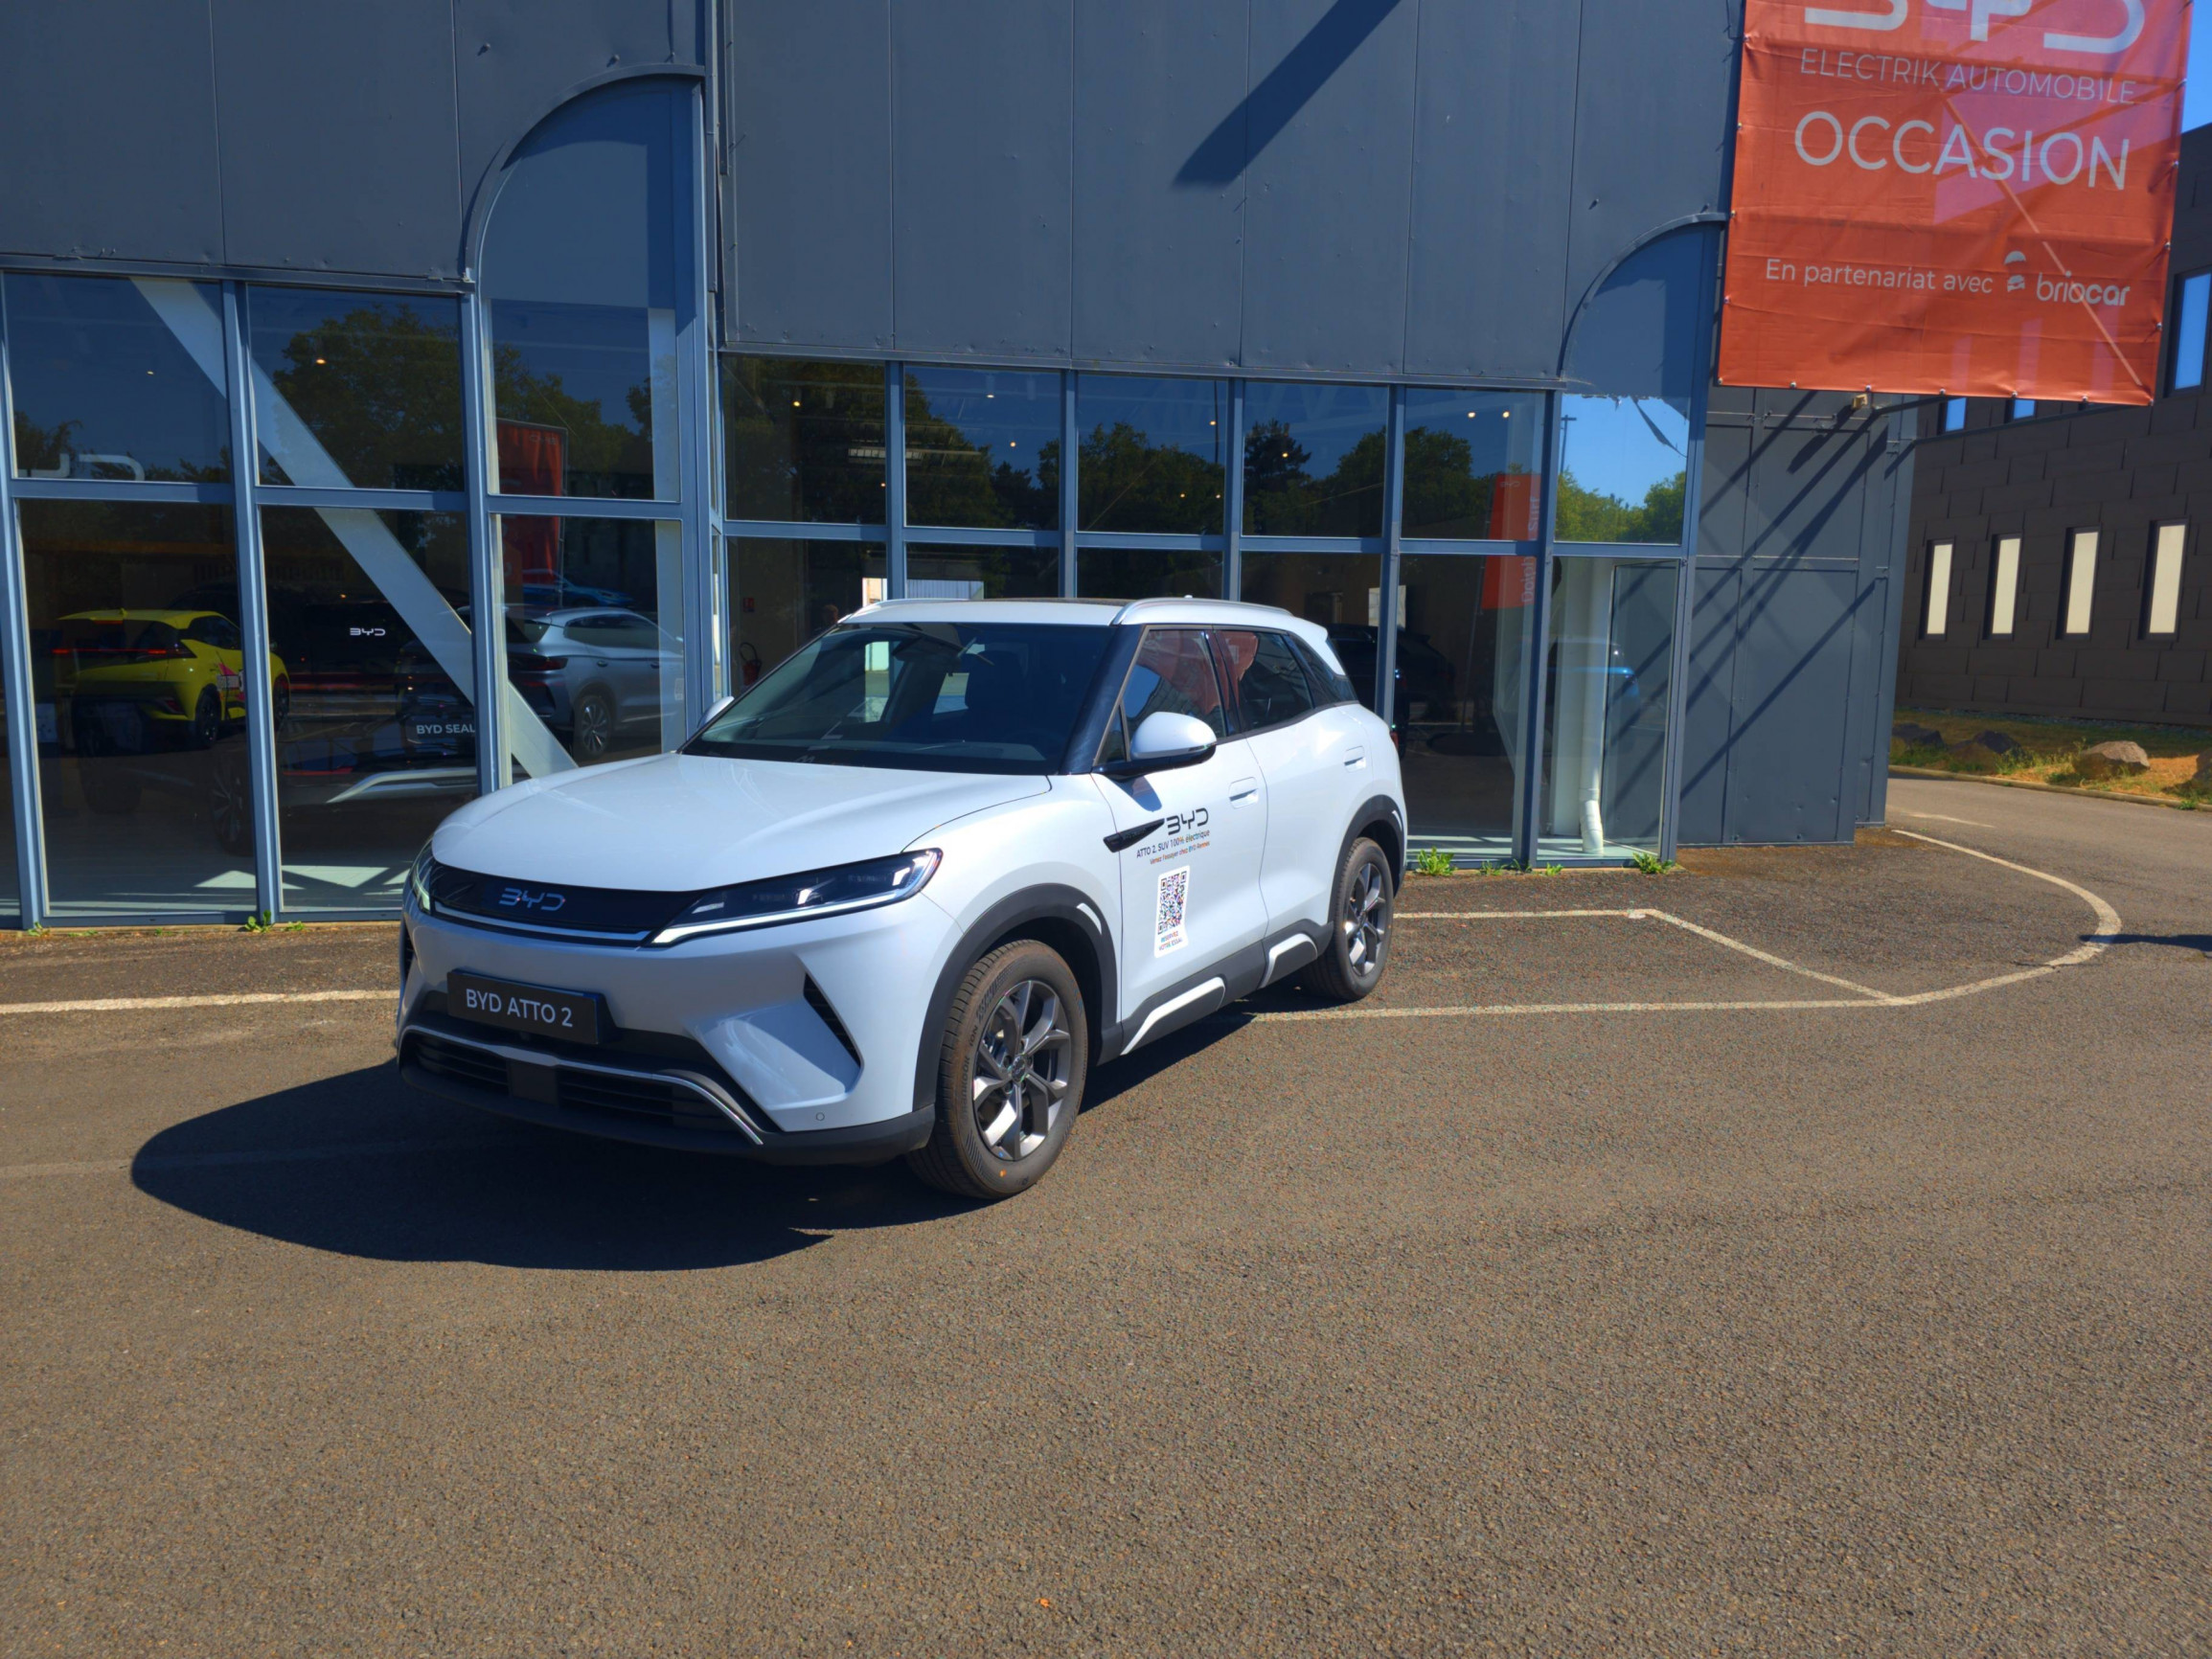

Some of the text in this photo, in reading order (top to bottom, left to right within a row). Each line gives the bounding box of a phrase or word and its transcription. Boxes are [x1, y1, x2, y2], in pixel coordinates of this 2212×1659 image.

[1801, 48, 2136, 105] ELECTRIK AUTOMOBILE
[1794, 111, 2131, 191] OCCASION
[1766, 259, 2131, 307] En partenariat avec briocar
[350, 627, 386, 637] BYD
[416, 723, 476, 735] BYD SEAL
[1166, 807, 1209, 835] BYD
[1136, 847, 1151, 858] ATTO
[1158, 840, 1169, 852] SUV
[1170, 836, 1184, 848] 100%
[498, 887, 565, 911] BYD
[466, 989, 573, 1028] BYD ATTO 2
